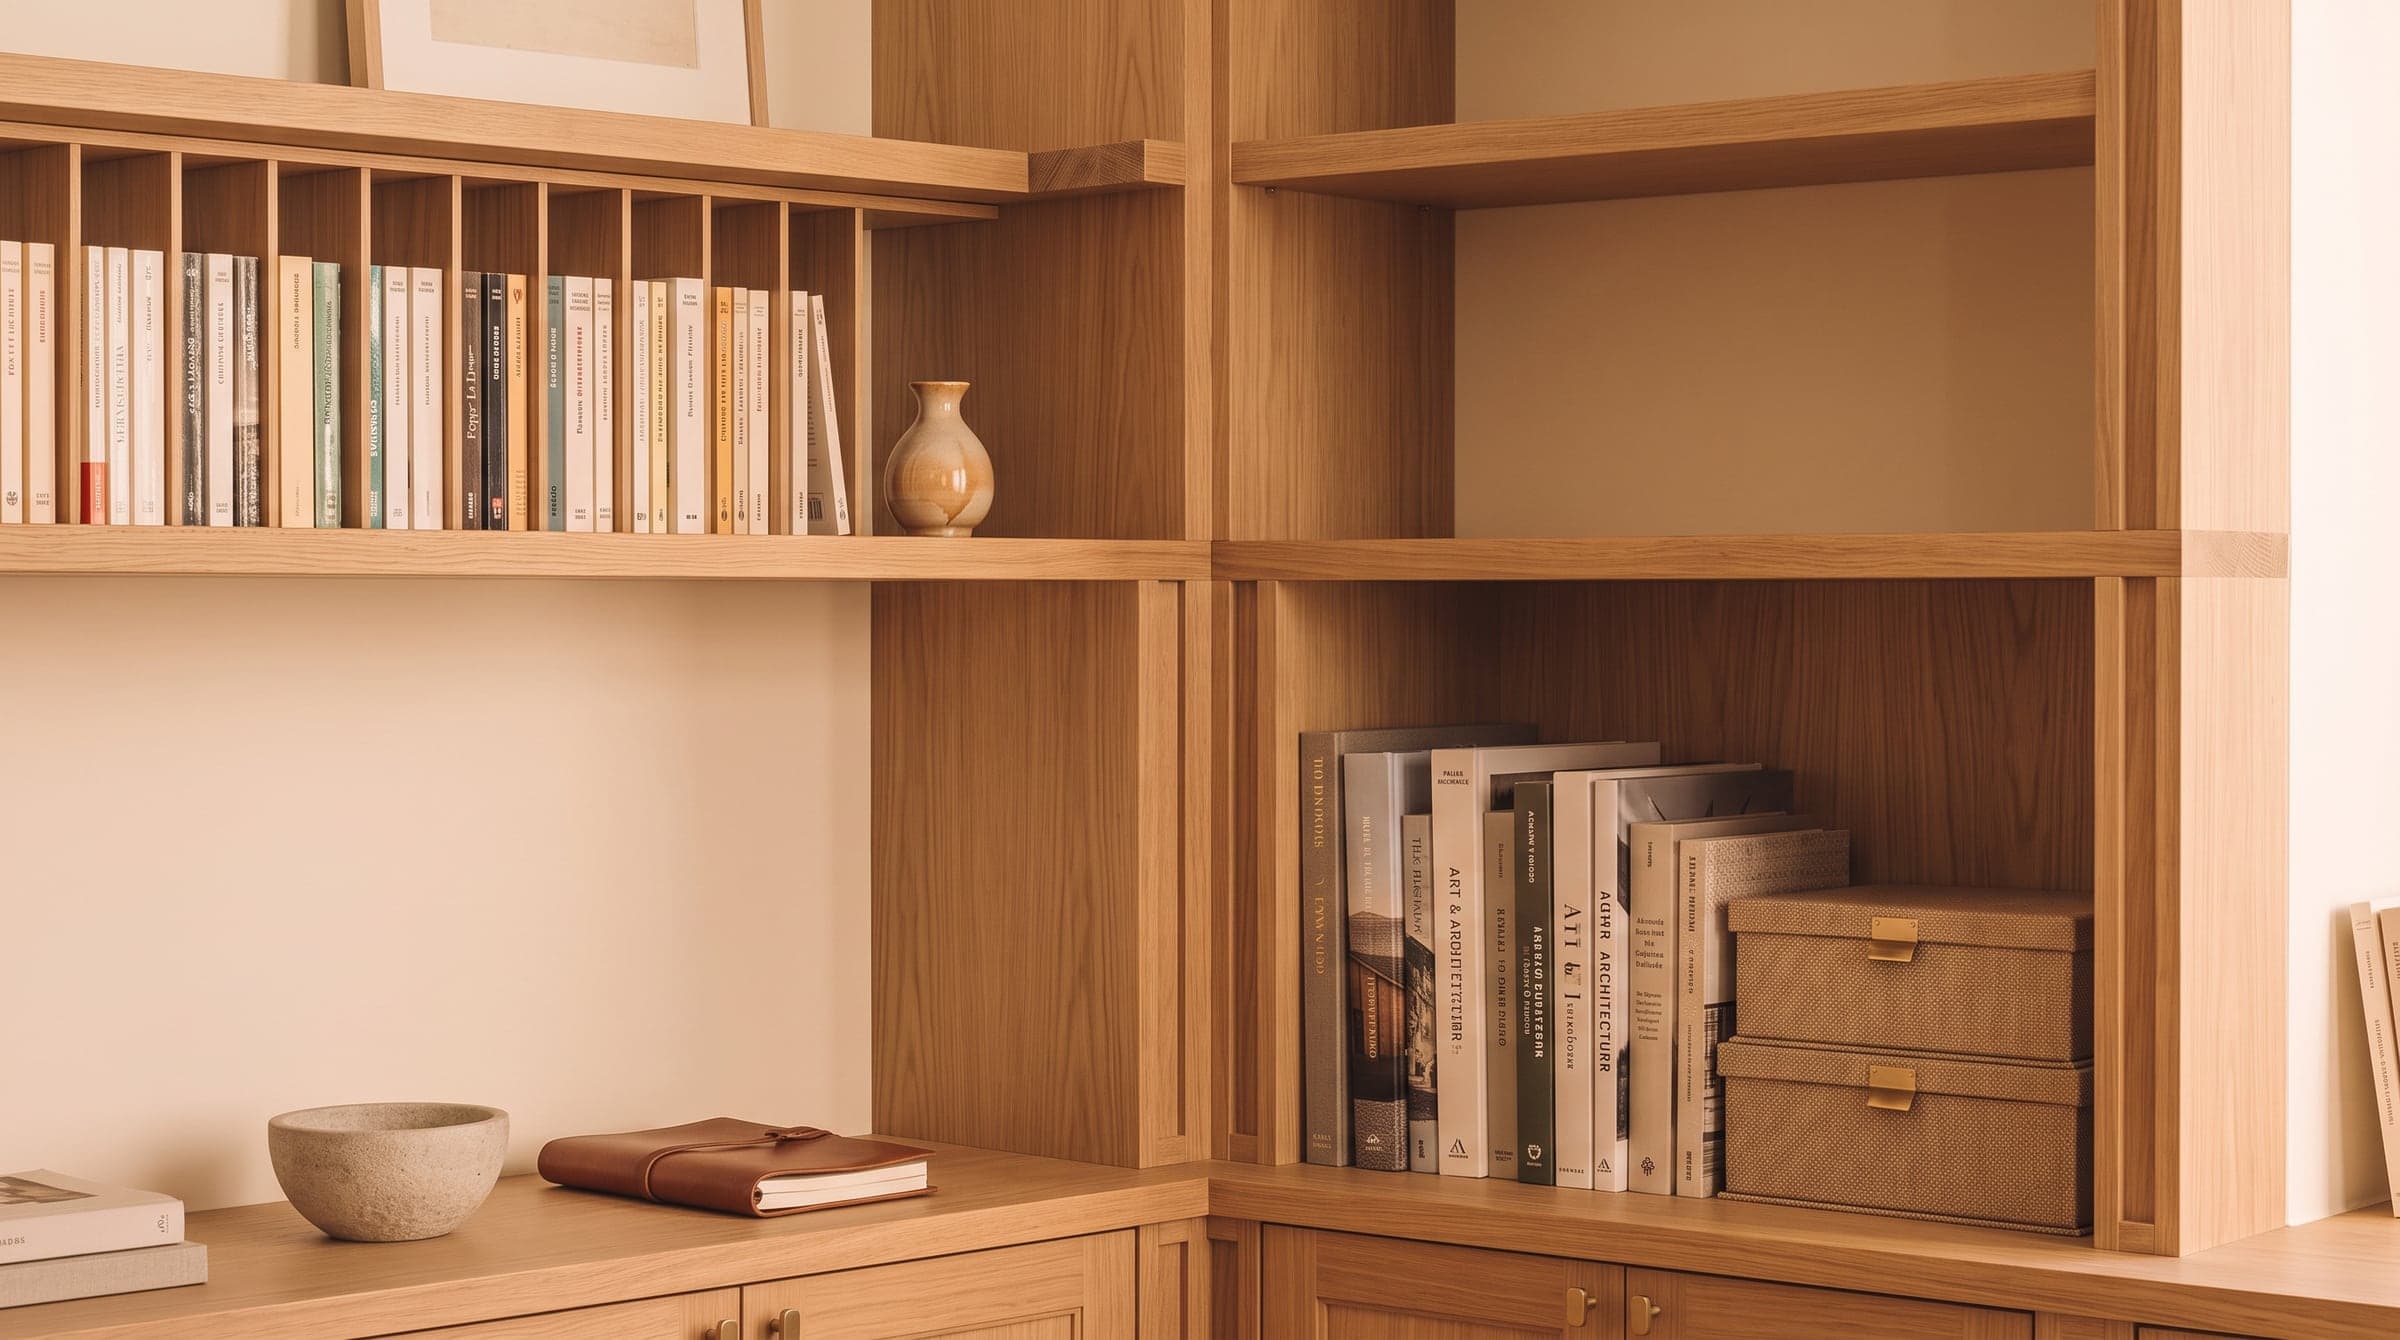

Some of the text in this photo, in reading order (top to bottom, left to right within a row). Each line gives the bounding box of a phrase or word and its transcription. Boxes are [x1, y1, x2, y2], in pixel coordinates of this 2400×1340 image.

[1449, 867, 1461, 897] ART
[1450, 904, 1462, 914] &
[1600, 951, 1611, 1072] ARCHITECTURR
